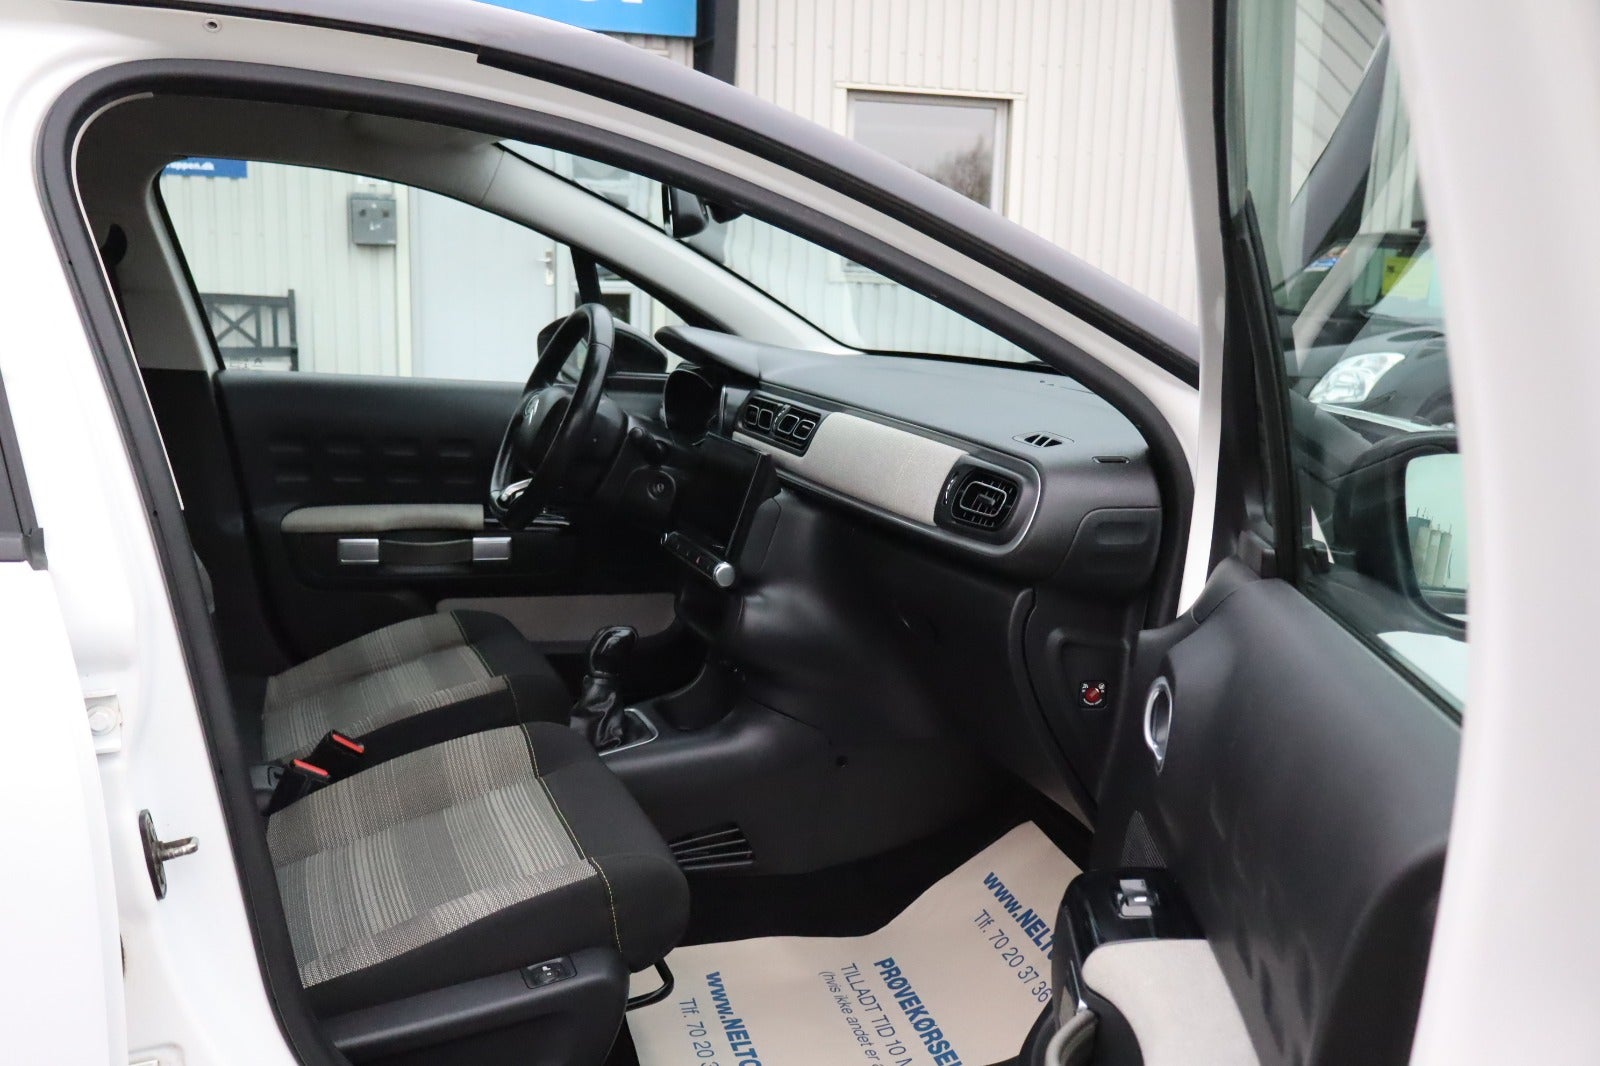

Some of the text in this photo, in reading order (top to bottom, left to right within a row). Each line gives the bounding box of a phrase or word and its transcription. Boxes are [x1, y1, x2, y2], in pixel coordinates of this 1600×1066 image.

[974, 909, 1053, 1003] Tlf. 70 20 37 36
[679, 997, 700, 1018] Tlf.
[687, 1021, 707, 1037] 70
[818, 971, 841, 993] (hvis
[834, 994, 853, 1015] ikke
[846, 1016, 875, 1047] andet
[865, 1049, 880, 1061] er
[841, 962, 883, 1012] TILLADT
[871, 1014, 896, 1038] TID
[885, 1039, 907, 1056] 10
[693, 1040, 715, 1058] 20
